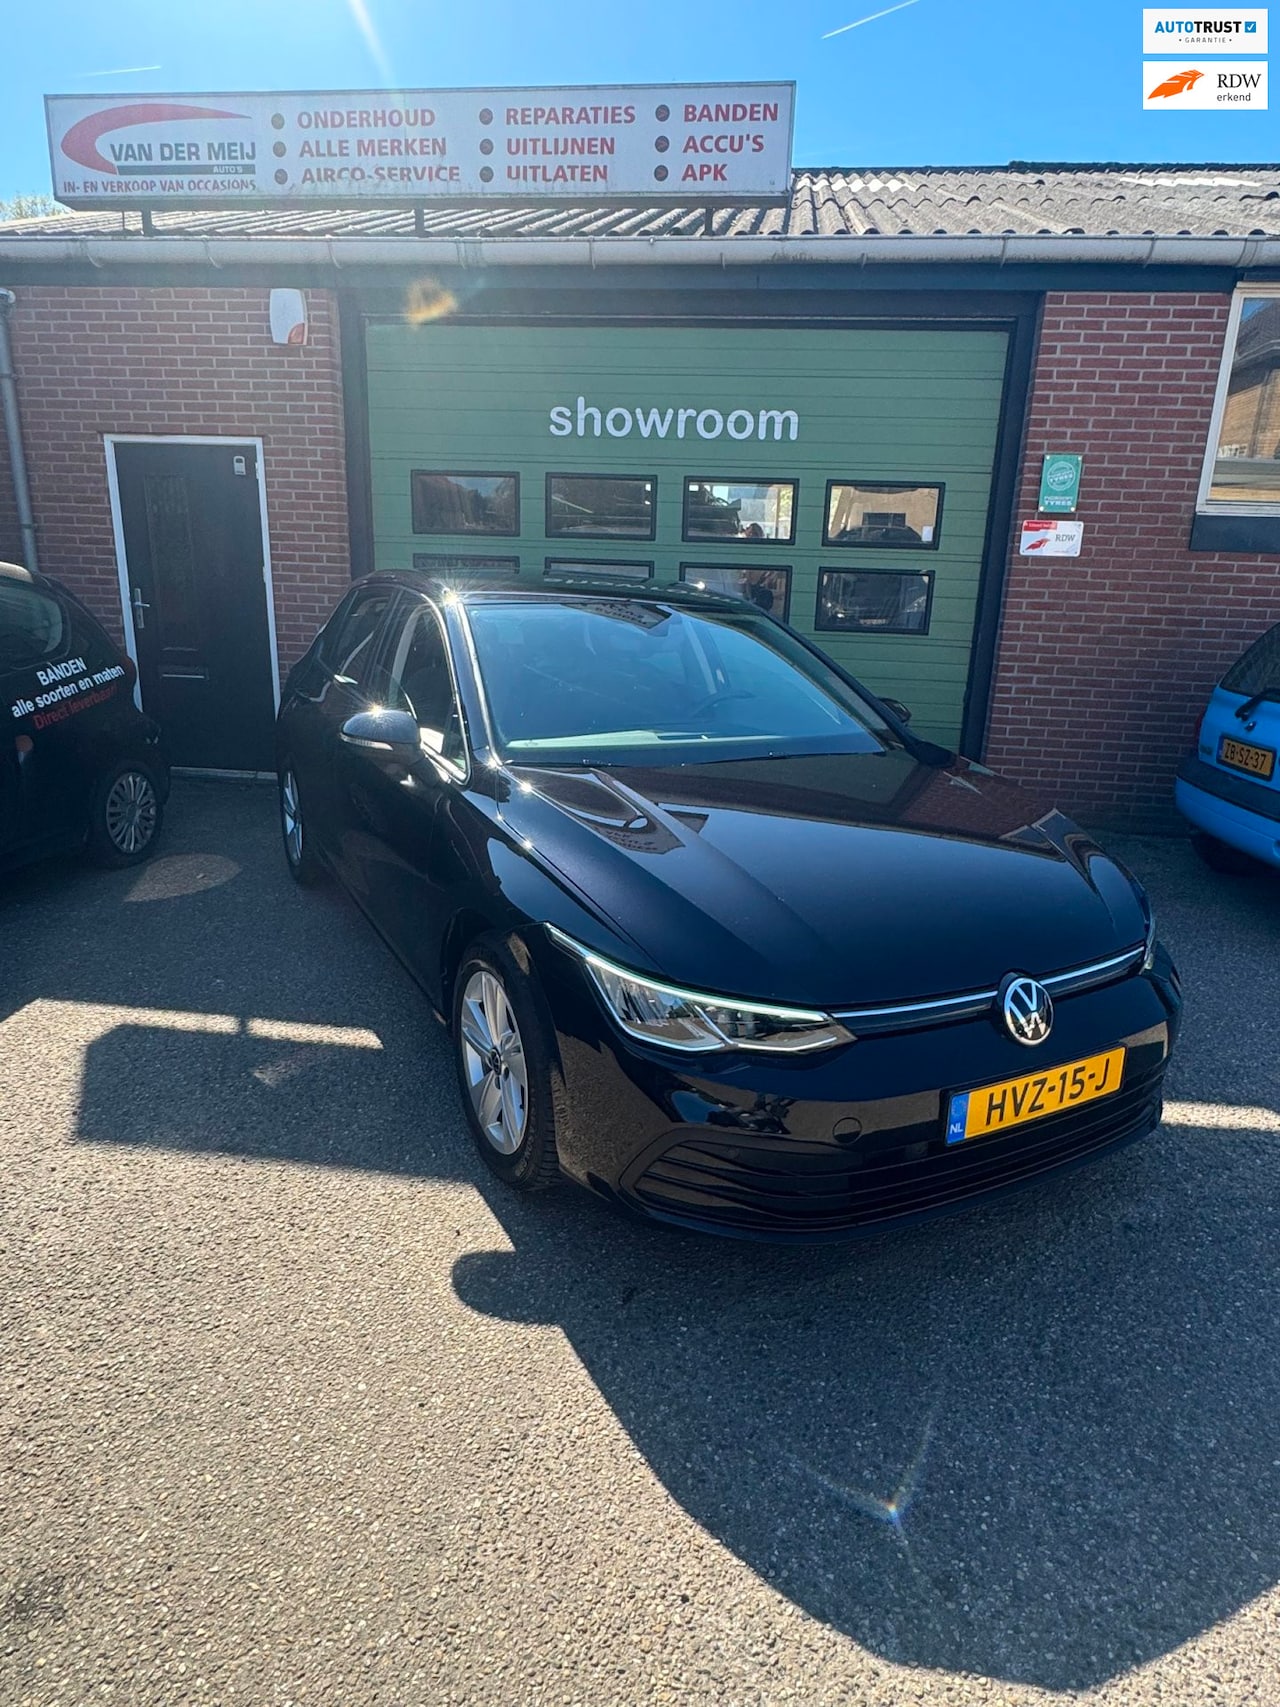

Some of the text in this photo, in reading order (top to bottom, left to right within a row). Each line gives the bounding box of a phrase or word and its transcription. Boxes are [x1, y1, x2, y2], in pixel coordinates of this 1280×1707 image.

[297, 108, 436, 129] ONDERHOUD
[504, 105, 636, 126] REPARATIES
[682, 102, 779, 123] BANDEN
[110, 142, 256, 162] VAN DER MEIJ
[299, 137, 447, 158] ALLE MERKEN
[506, 137, 616, 156] UITLIJNEN
[682, 133, 765, 153] ACCU'S
[301, 166, 461, 185] AIRCO-SERVICE
[506, 164, 609, 183] UITLATEN
[681, 163, 728, 182] APK
[63, 178, 257, 193] IN- EN VERKOOP VAN OCCASIONS
[549, 396, 800, 441] showroom
[1055, 533, 1076, 542] RDW
[36, 657, 88, 686] BANDEN
[11, 665, 125, 718] alle soorten en maten
[33, 704, 70, 730] Direct
[985, 1057, 1110, 1127] HVZ-15-J
[949, 1121, 964, 1135] NL
